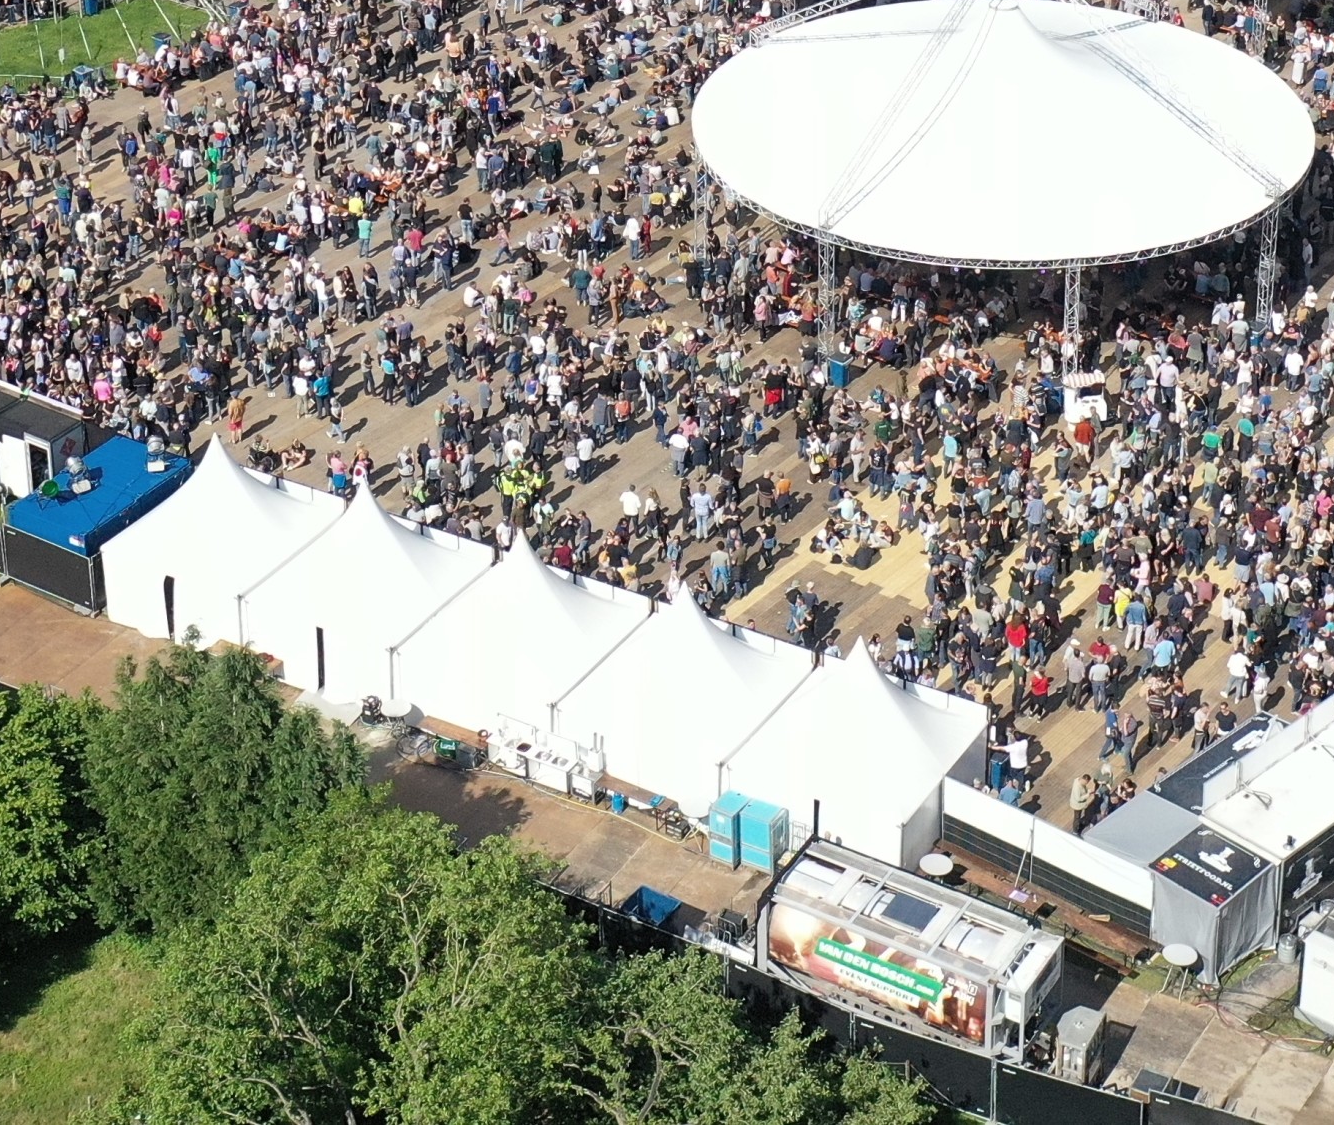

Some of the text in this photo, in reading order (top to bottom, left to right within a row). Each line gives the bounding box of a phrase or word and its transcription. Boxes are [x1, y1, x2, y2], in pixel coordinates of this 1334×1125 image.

[819, 942, 842, 959] VAN
[843, 952, 870, 970] DEN
[839, 968, 916, 1003] EVENT SUPPORT
